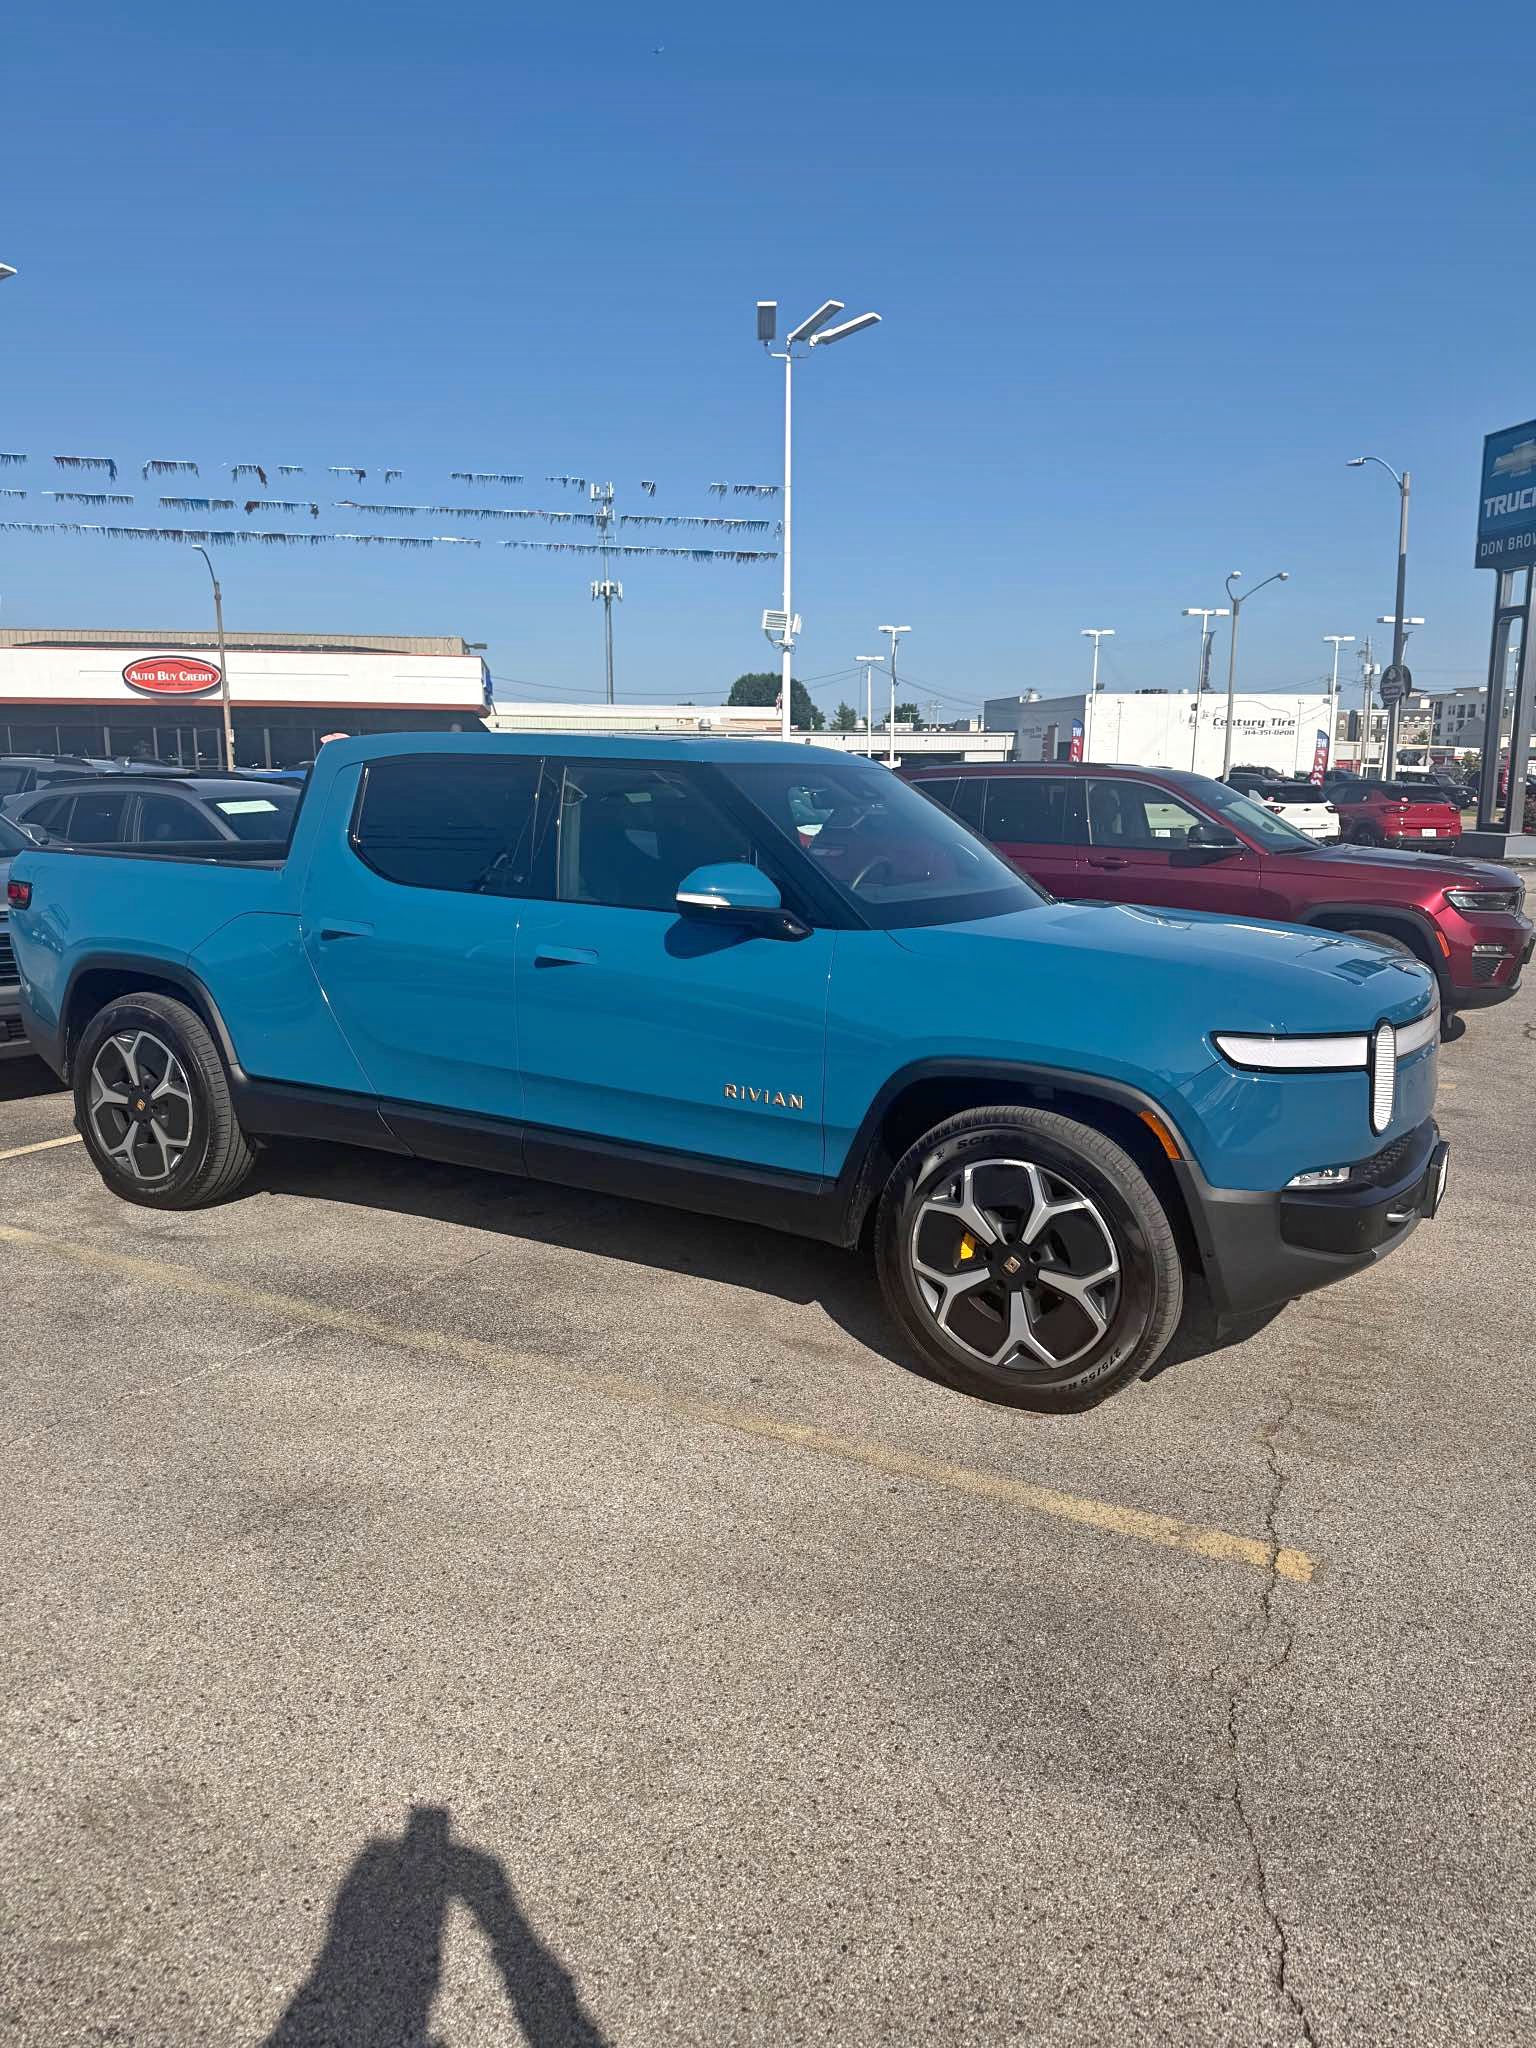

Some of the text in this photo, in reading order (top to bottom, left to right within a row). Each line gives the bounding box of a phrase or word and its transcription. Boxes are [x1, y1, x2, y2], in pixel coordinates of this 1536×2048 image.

[1481, 539, 1504, 557] DON
[130, 670, 214, 682] AUTO BUY CREDIT
[1212, 717, 1296, 728] Century Tire
[723, 1082, 804, 1110] RIVIAN
